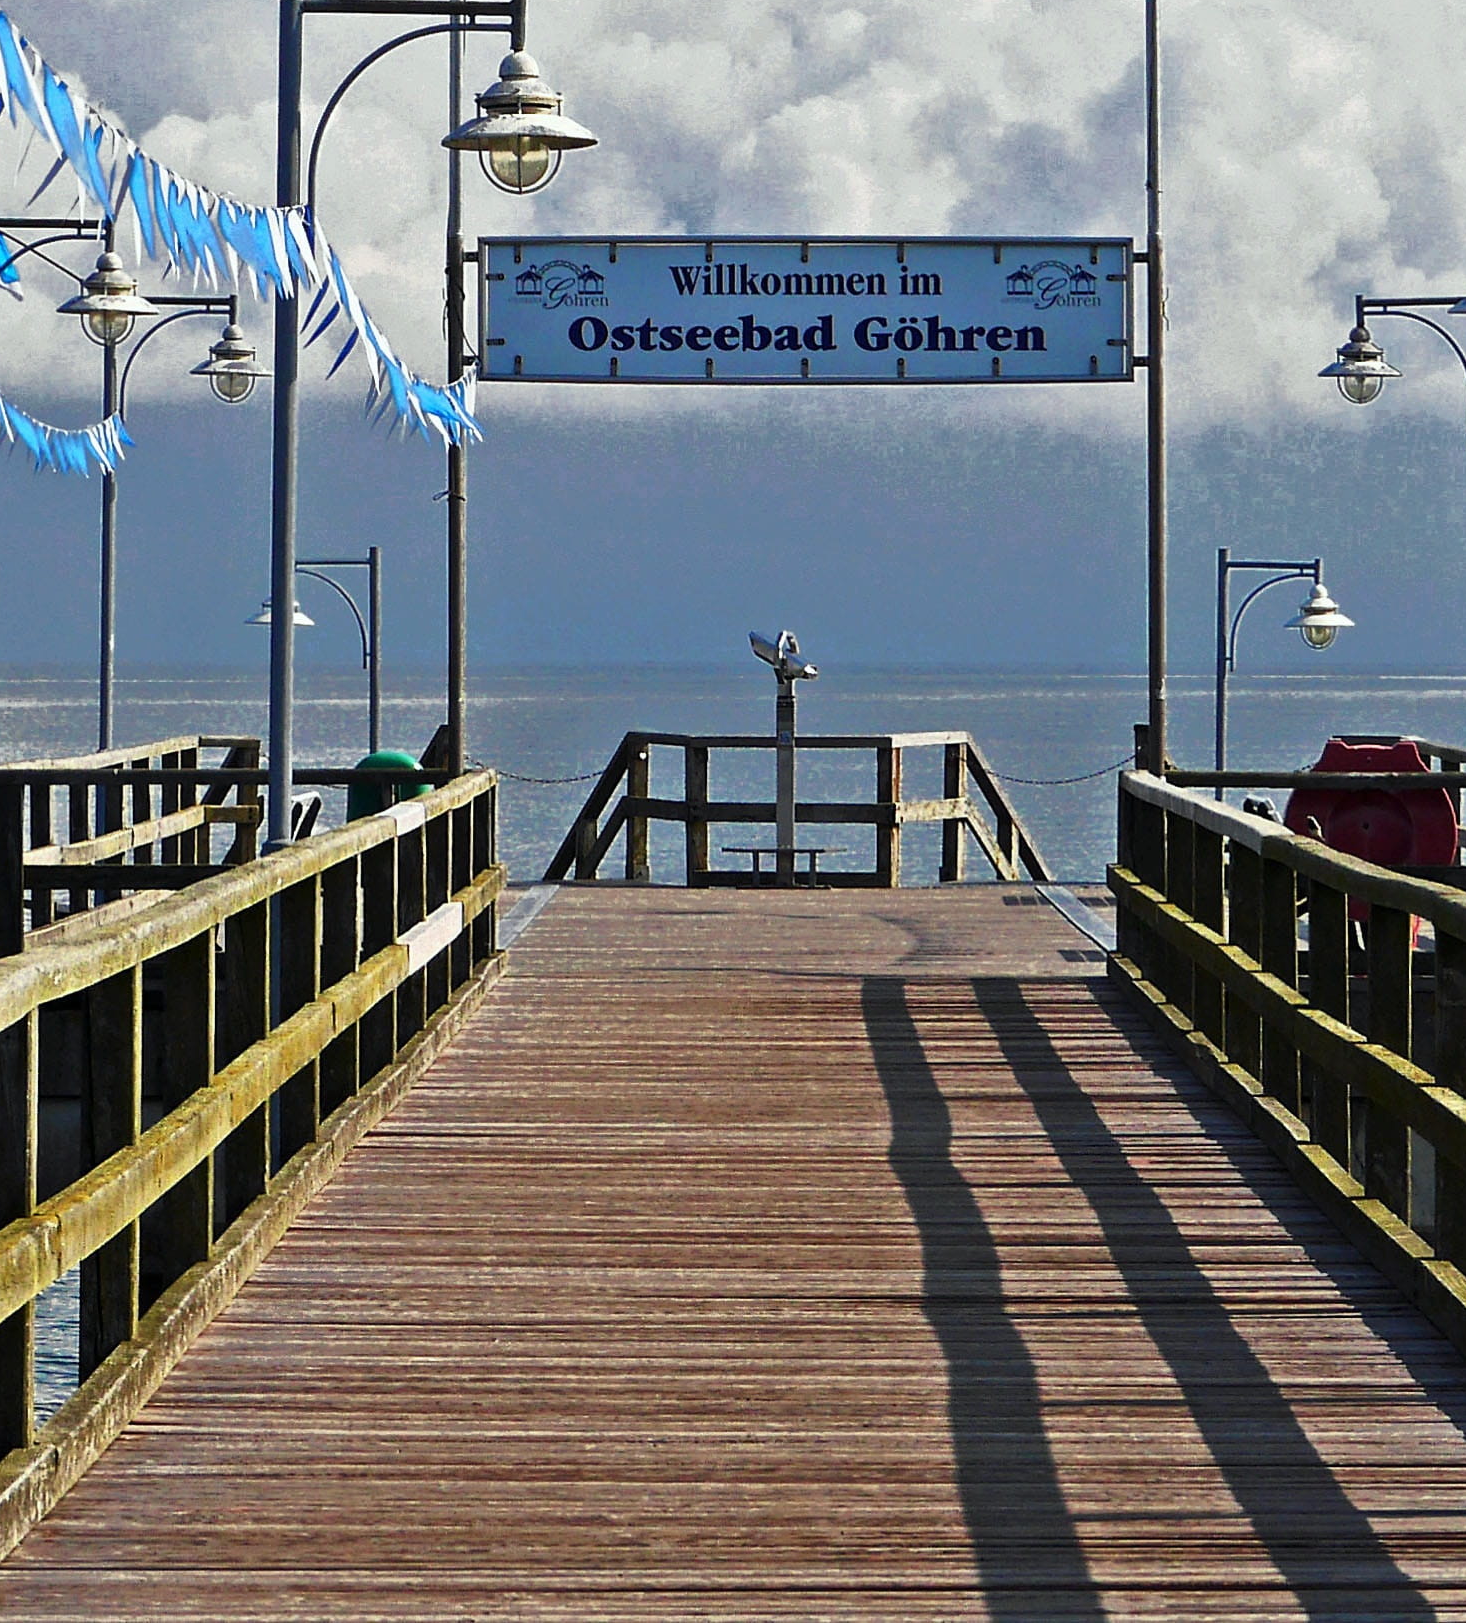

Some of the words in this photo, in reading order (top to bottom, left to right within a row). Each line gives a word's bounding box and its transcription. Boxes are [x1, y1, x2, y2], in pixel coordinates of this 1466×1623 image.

[543, 277, 609, 309] Göhren
[668, 264, 887, 295] Willkommen
[900, 265, 942, 295] im
[1034, 277, 1101, 309] Göhren
[568, 315, 837, 351] Ostseebad
[853, 315, 1047, 351] Göhren
